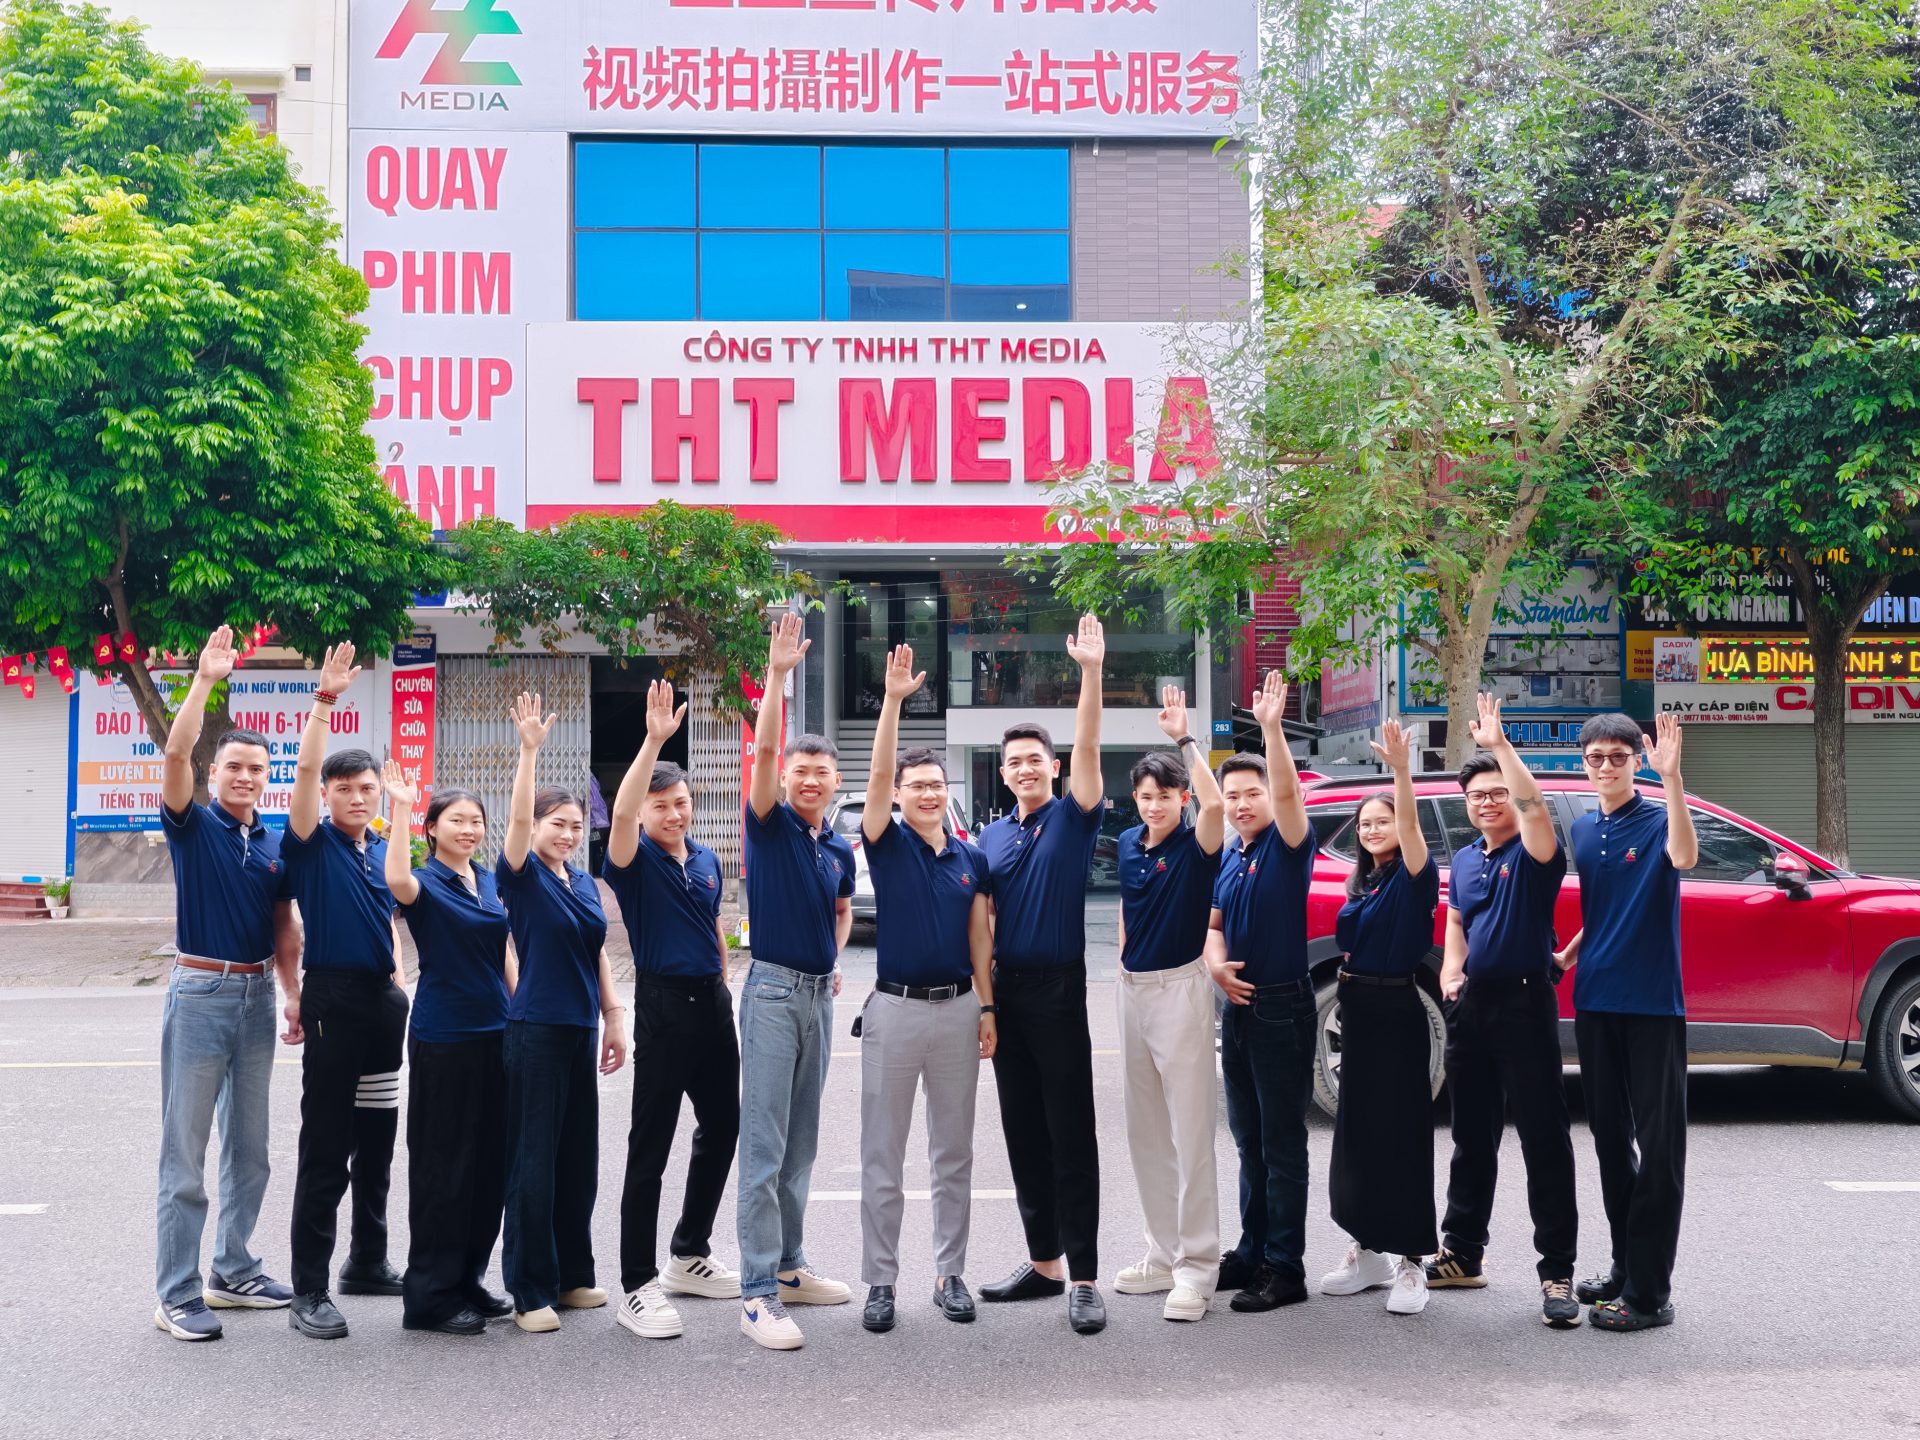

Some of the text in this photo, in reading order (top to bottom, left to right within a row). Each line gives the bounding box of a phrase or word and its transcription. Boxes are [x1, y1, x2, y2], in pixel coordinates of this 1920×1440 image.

[401, 91, 509, 111] MEDIA
[366, 145, 508, 217] QUAY
[363, 250, 511, 315] PHIM
[683, 330, 1106, 363] CÔNG TY TNHH THT MEDIA
[361, 356, 512, 436] CHỤP
[577, 377, 1222, 481] THT MEDIA
[1518, 594, 1613, 625] Standard
[1757, 648, 1814, 673] BÌNH
[230, 682, 248, 696] OẠI
[251, 680, 276, 694] NGỮ
[395, 676, 433, 692] CHUYÊN
[404, 697, 423, 714] SỬA
[1662, 700, 1769, 713] DÂY CÁP ĐIỆN
[96, 707, 131, 735] ĐÀO
[234, 711, 269, 734] ANH
[330, 702, 359, 734] UỔI
[400, 720, 426, 736] CHỮA
[1215, 723, 1230, 732] 263
[401, 745, 425, 759] THAY
[100, 763, 144, 783] LUYỆN
[270, 761, 298, 782] YỆN
[99, 787, 134, 809] TIẾNG
